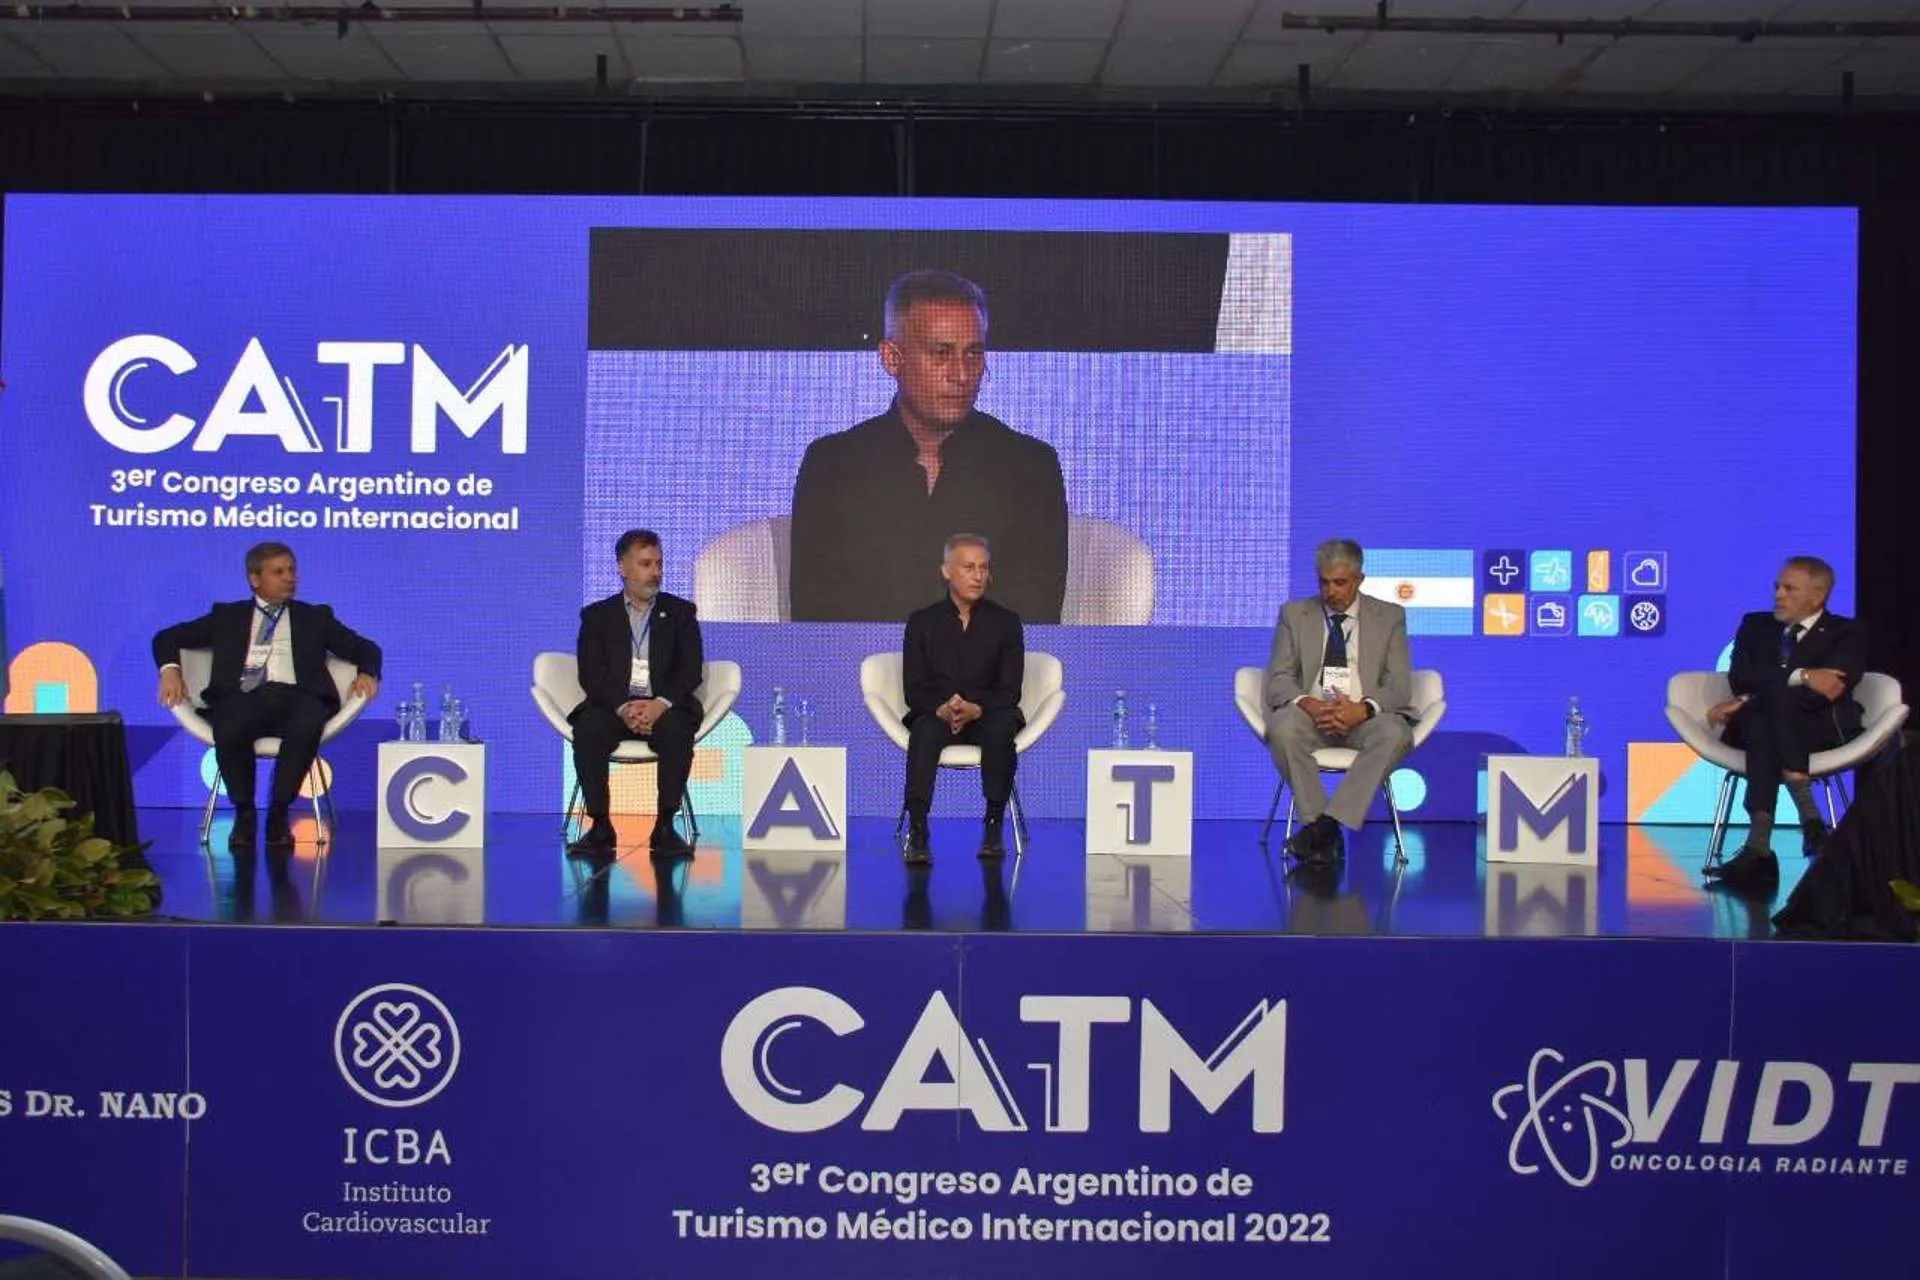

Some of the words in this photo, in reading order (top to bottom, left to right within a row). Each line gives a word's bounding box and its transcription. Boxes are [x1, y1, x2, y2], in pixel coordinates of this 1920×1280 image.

[83, 334, 529, 455] CATM
[111, 468, 157, 493] 3er
[163, 471, 301, 503] Congreso
[307, 471, 451, 505] Argentino
[457, 473, 493, 496] de
[90, 503, 207, 527] Turismo
[214, 502, 318, 528] Médico
[324, 505, 519, 530] Internacional
[720, 986, 1287, 1134] CATM
[99, 1091, 207, 1120] NANO
[1623, 1058, 1920, 1147] VIDT
[343, 1127, 452, 1165] ICBA
[1610, 1154, 1761, 1173] ONCOLOGIA
[1775, 1157, 1908, 1175] RADIANTE
[343, 1180, 451, 1204] Instituto
[750, 1162, 811, 1193] 3er
[818, 1165, 1002, 1204] Congreso
[1010, 1165, 1198, 1205] Argentino
[1206, 1167, 1253, 1196] de
[303, 1210, 492, 1235] Cardiovascular
[672, 1207, 828, 1240] Turismo
[837, 1209, 973, 1240] Médico
[982, 1211, 1236, 1242] Internacional
[1244, 1213, 1331, 1242] 2022
